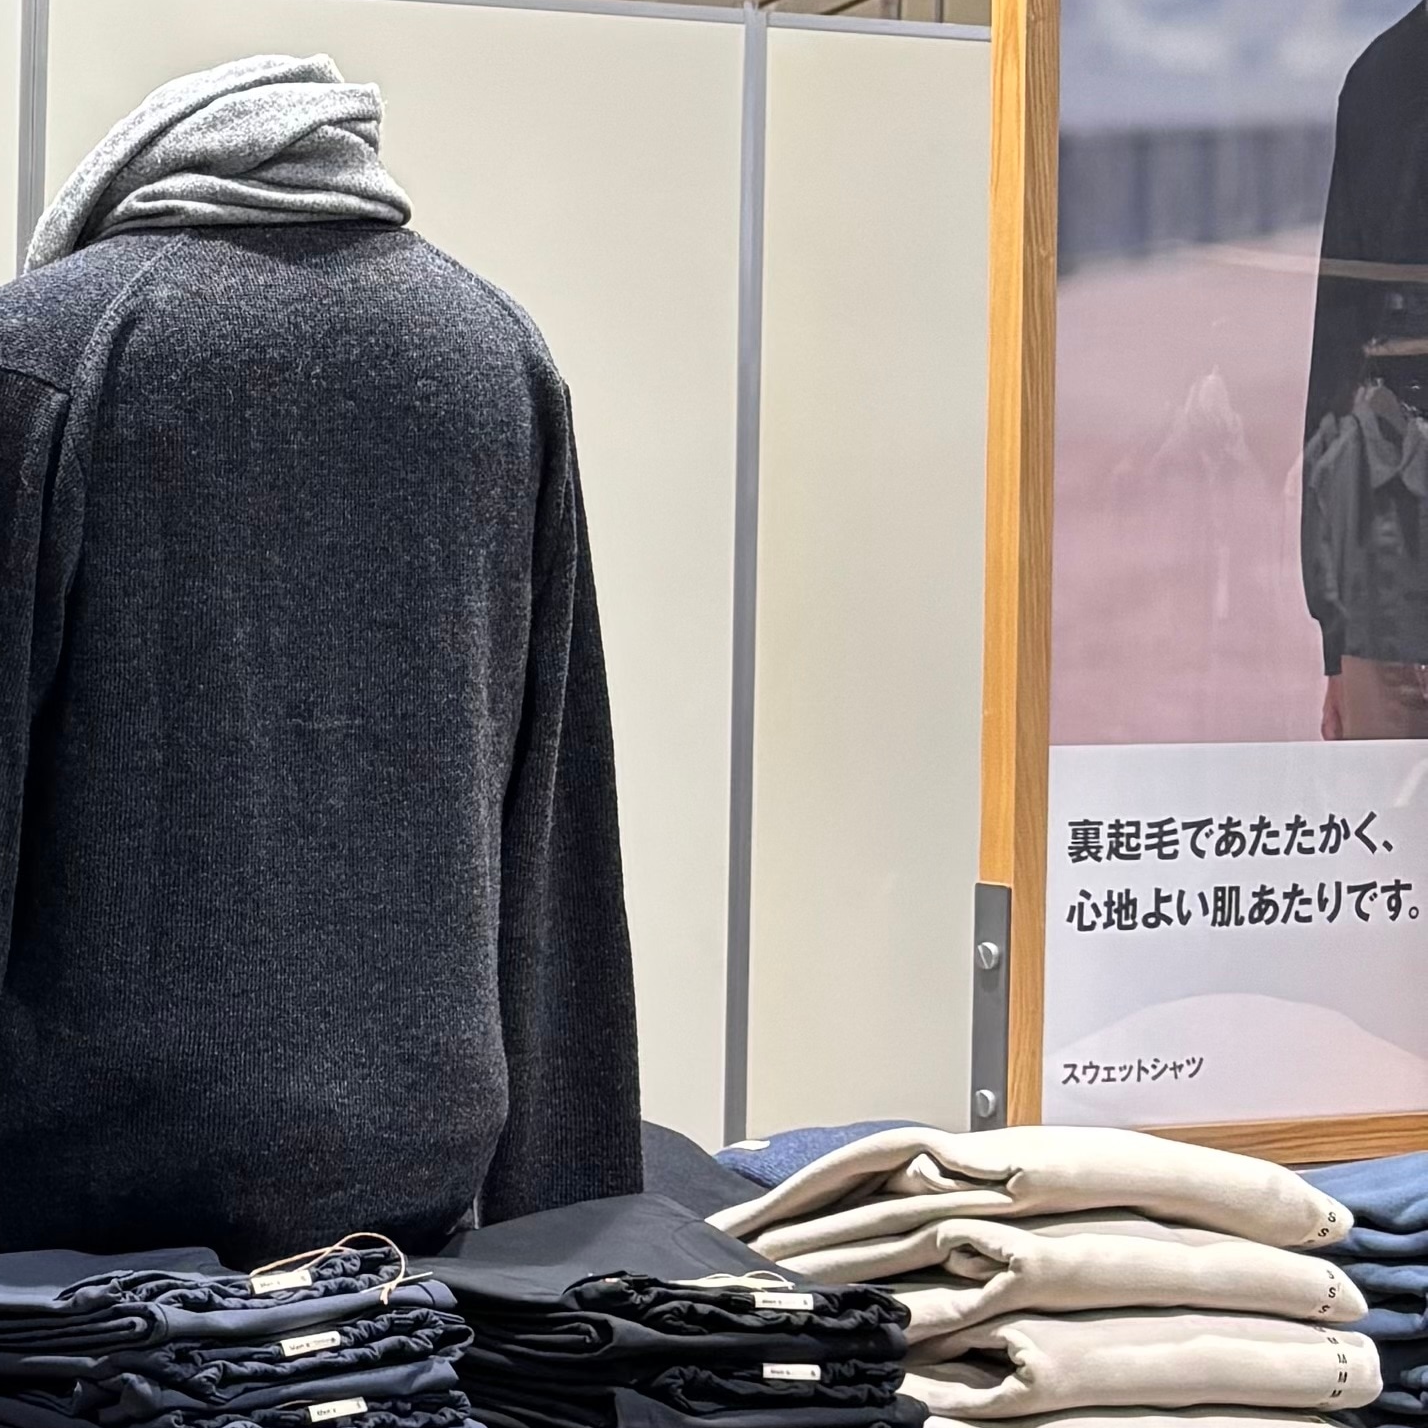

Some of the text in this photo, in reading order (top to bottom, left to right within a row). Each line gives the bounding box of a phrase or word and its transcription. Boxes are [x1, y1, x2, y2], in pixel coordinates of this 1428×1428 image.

[1066, 811, 1394, 863] 裏起毛であたたかく、
[1066, 878, 1420, 932] 心地よい肌あたりです。
[1061, 1056, 1204, 1085] スウェットシャツ
[1317, 1211, 1336, 1237] S S
[1328, 1286, 1336, 1299] S
